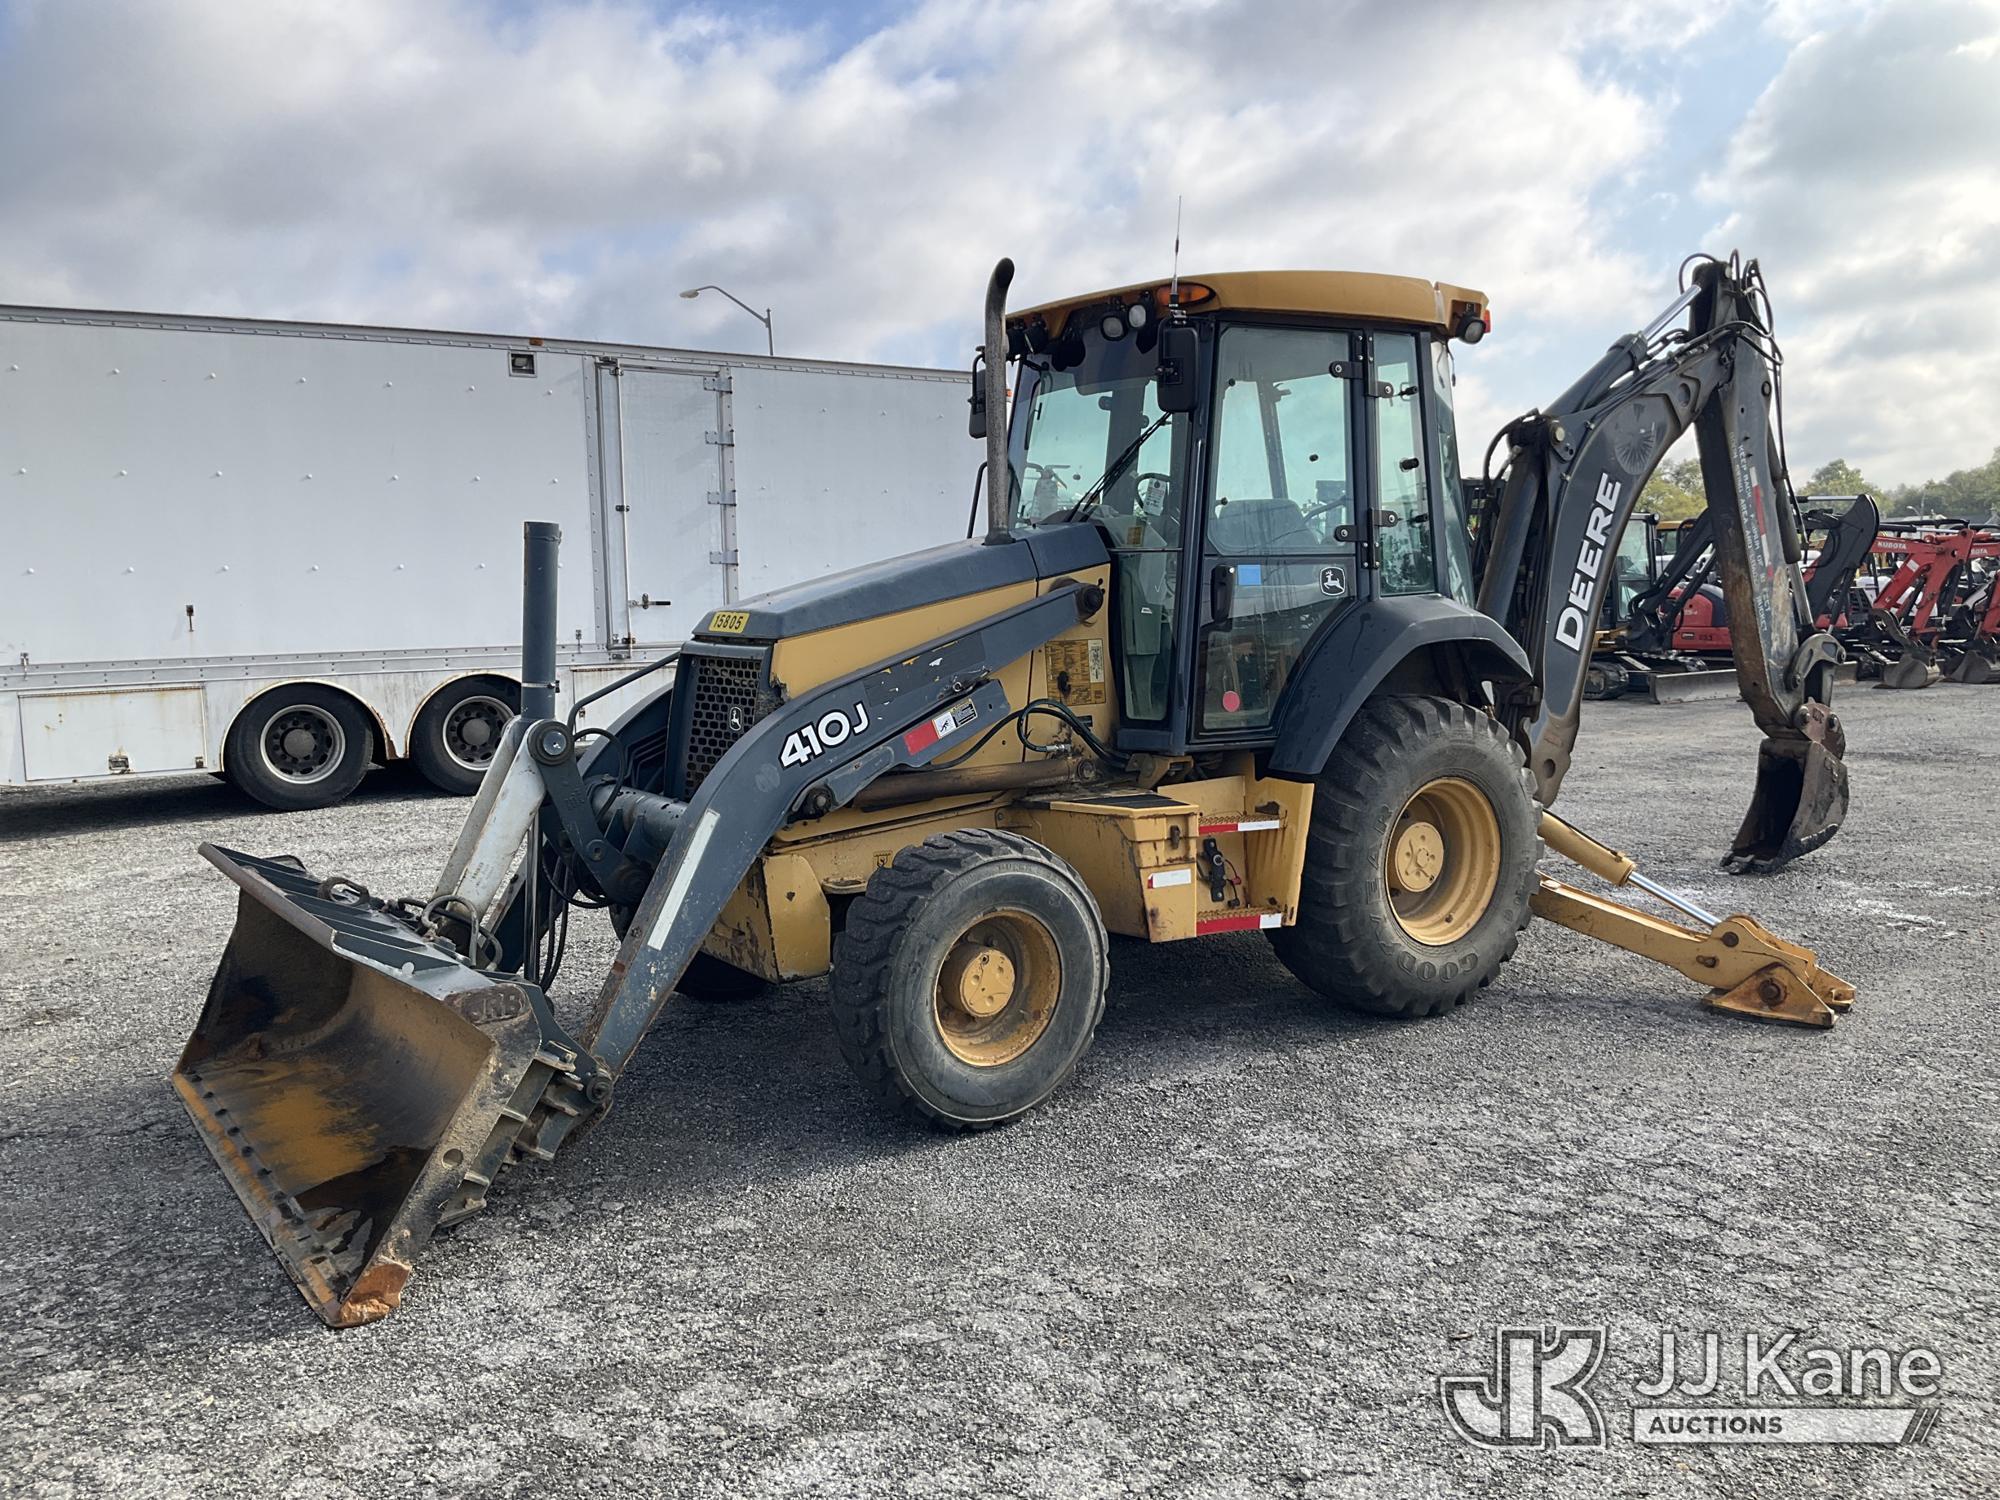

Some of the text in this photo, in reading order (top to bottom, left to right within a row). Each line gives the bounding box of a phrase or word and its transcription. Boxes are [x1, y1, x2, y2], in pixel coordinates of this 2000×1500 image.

[1737, 444, 1747, 471] KEEP
[1742, 473, 1752, 497] BACK
[1739, 498, 1749, 524] AREA
[1744, 529, 1753, 548] AND
[1877, 541, 1907, 550] KUBOTA
[1555, 472, 1622, 652] DEERE
[713, 614, 744, 630] 15805
[779, 702, 870, 768] 410J
